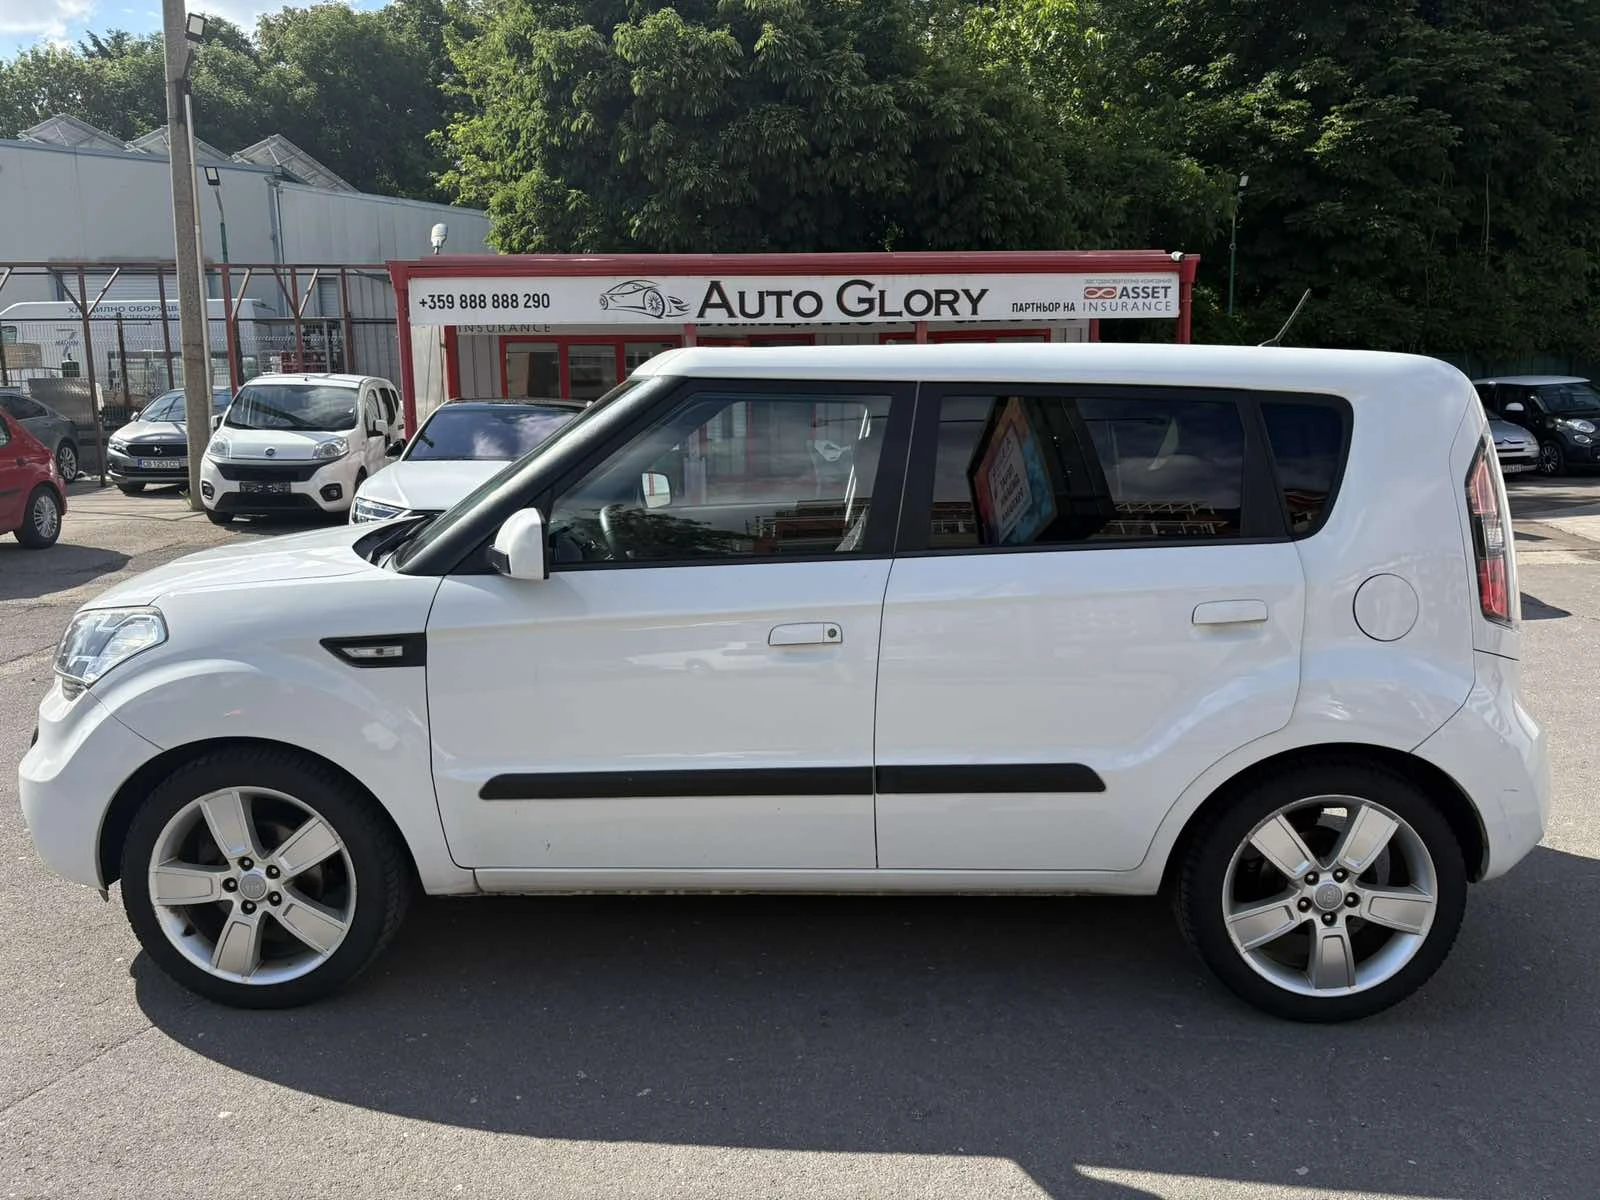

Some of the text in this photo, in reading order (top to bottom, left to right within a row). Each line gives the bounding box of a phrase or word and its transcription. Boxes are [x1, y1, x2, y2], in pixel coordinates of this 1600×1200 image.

[697, 279, 990, 319] AUTO GLORY
[1118, 286, 1171, 299] ASSET
[419, 293, 551, 309] +359 888 888 290
[1011, 301, 1076, 313] ПАРТНЬОР НА
[1082, 301, 1172, 312] INSURANCE
